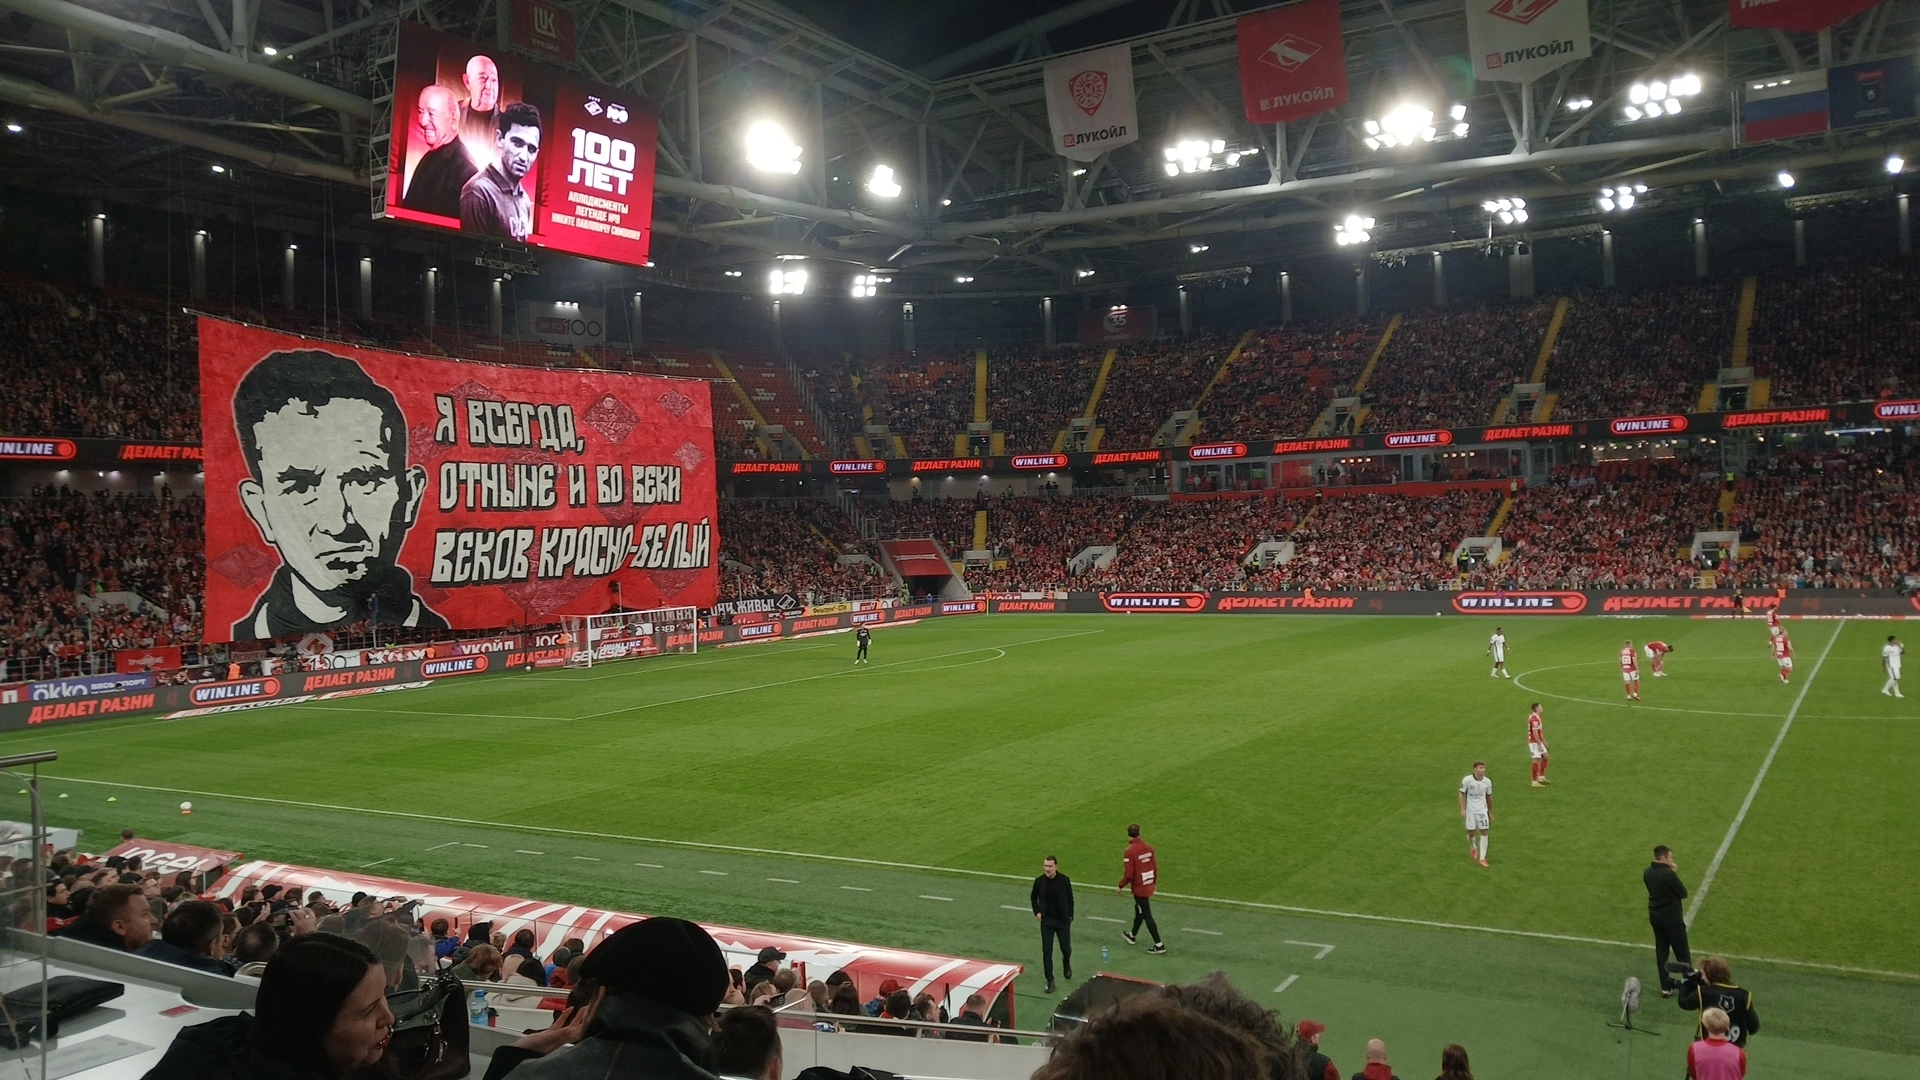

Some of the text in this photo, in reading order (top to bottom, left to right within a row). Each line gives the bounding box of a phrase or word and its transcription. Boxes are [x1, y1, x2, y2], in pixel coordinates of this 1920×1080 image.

[1503, 40, 1574, 64] ЛУКОЙЛ
[1273, 87, 1335, 108] ЛУКОЙЛ
[1076, 125, 1127, 144] ЛУКОЙЛ
[572, 127, 636, 172] 100
[567, 158, 633, 196] ЛЕТ
[564, 319, 601, 336] 100
[435, 394, 585, 453] Я ВСЕГДА,
[1616, 419, 1670, 432] WINLINE
[1726, 413, 1780, 427] ДЕЛАЕТ
[1389, 433, 1436, 445] WINLINE
[1485, 427, 1531, 441] ДЕЛАЕТ
[0, 442, 54, 455] INLINE
[122, 445, 181, 460] ДЕЛАЕТ
[1193, 447, 1233, 457] WINLINE
[1275, 440, 1315, 454] ДЕЛАЕТ
[913, 460, 949, 471] ДЕЛАЕТ
[1015, 457, 1055, 466] WINLINE
[1094, 453, 1131, 464] ДЕЛАЕТ
[733, 463, 768, 473] ДЕЛАЕТ
[833, 462, 874, 472] WINLINE
[439, 461, 682, 511] ОТНЫНЕ И ВО ВЕКИ
[430, 517, 712, 587] ВЕКОВ КРАСНО-БЕЛЫЙ
[736, 599, 775, 613] ЖИВЫ!
[943, 603, 976, 611] WINLINE
[999, 603, 1028, 611] ДЕЛАЕТ
[853, 613, 878, 623] WINLINE
[742, 624, 772, 636] WINLINE
[461, 639, 515, 654] УКОЙЛ
[426, 660, 473, 675] WINLINE
[303, 672, 355, 692] ДЕЛАЕТ
[196, 683, 260, 701] WINLINE
[28, 700, 98, 724] ДЕЛАЕТ
